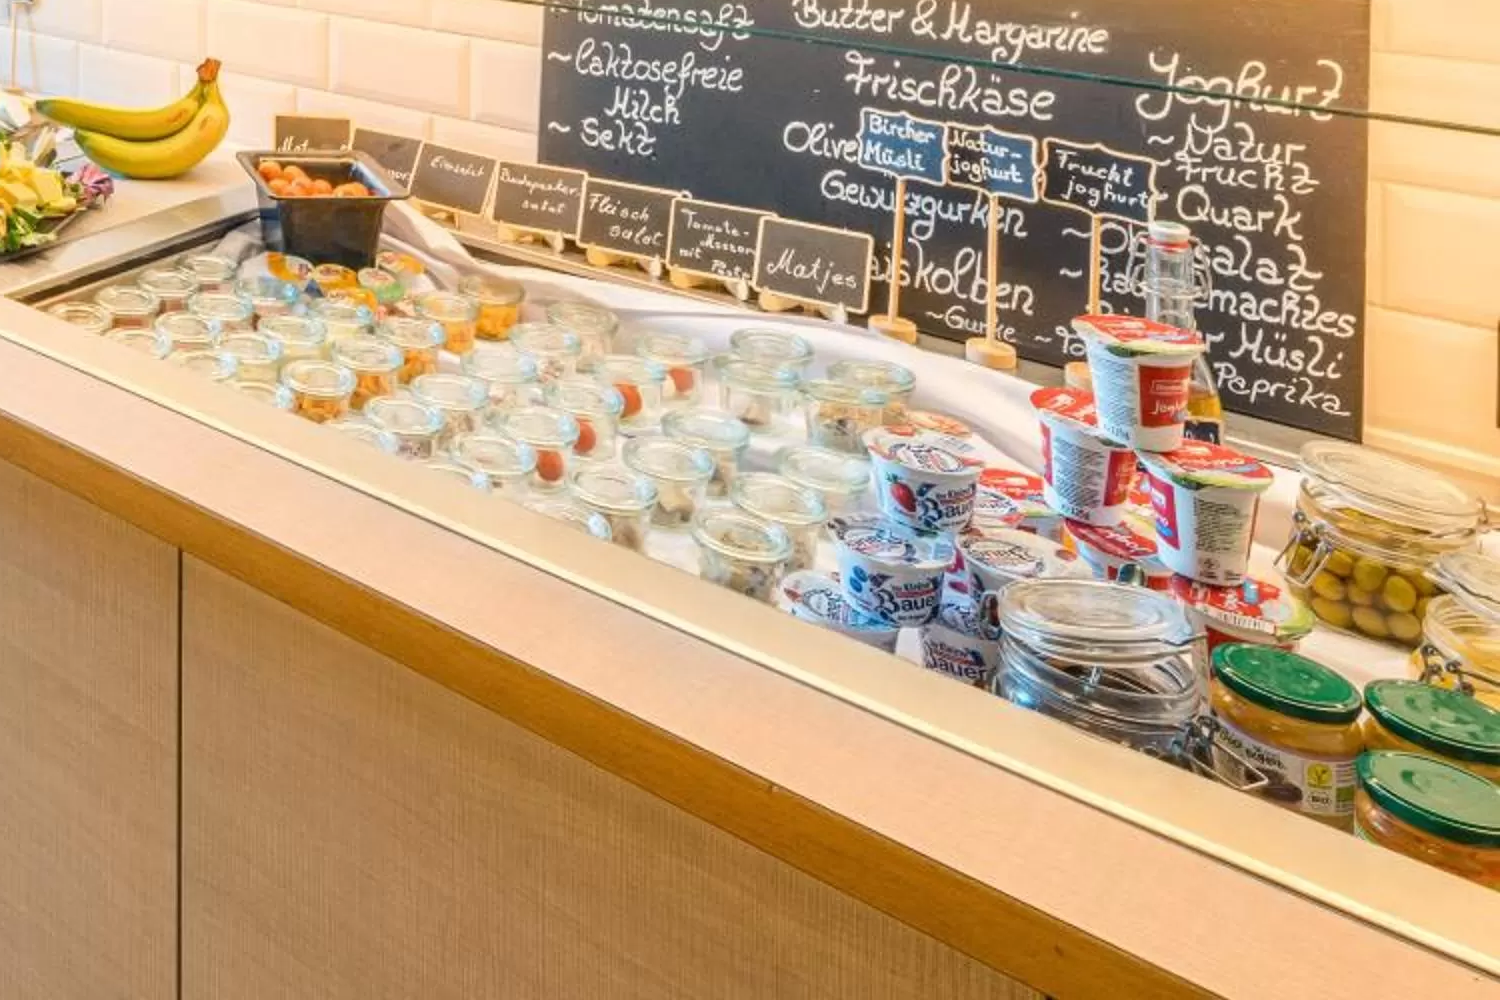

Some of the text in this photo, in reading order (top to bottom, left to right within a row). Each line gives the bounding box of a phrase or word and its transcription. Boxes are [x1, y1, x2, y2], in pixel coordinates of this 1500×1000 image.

[941, 0, 1109, 64] Margarine
[604, 85, 681, 125] Milch
[845, 50, 1056, 120] Frischkäse
[1136, 52, 1343, 132] Joghurt
[580, 117, 657, 156] Sekt
[783, 121, 859, 162] Olive
[864, 139, 925, 171] Müsli
[950, 154, 1025, 183] joghurt
[1060, 175, 1149, 208] joghurt
[1177, 185, 1303, 240] Quark
[766, 248, 857, 295] Matjes
[870, 237, 1034, 316] aiskolben
[1229, 321, 1343, 378] Müsli
